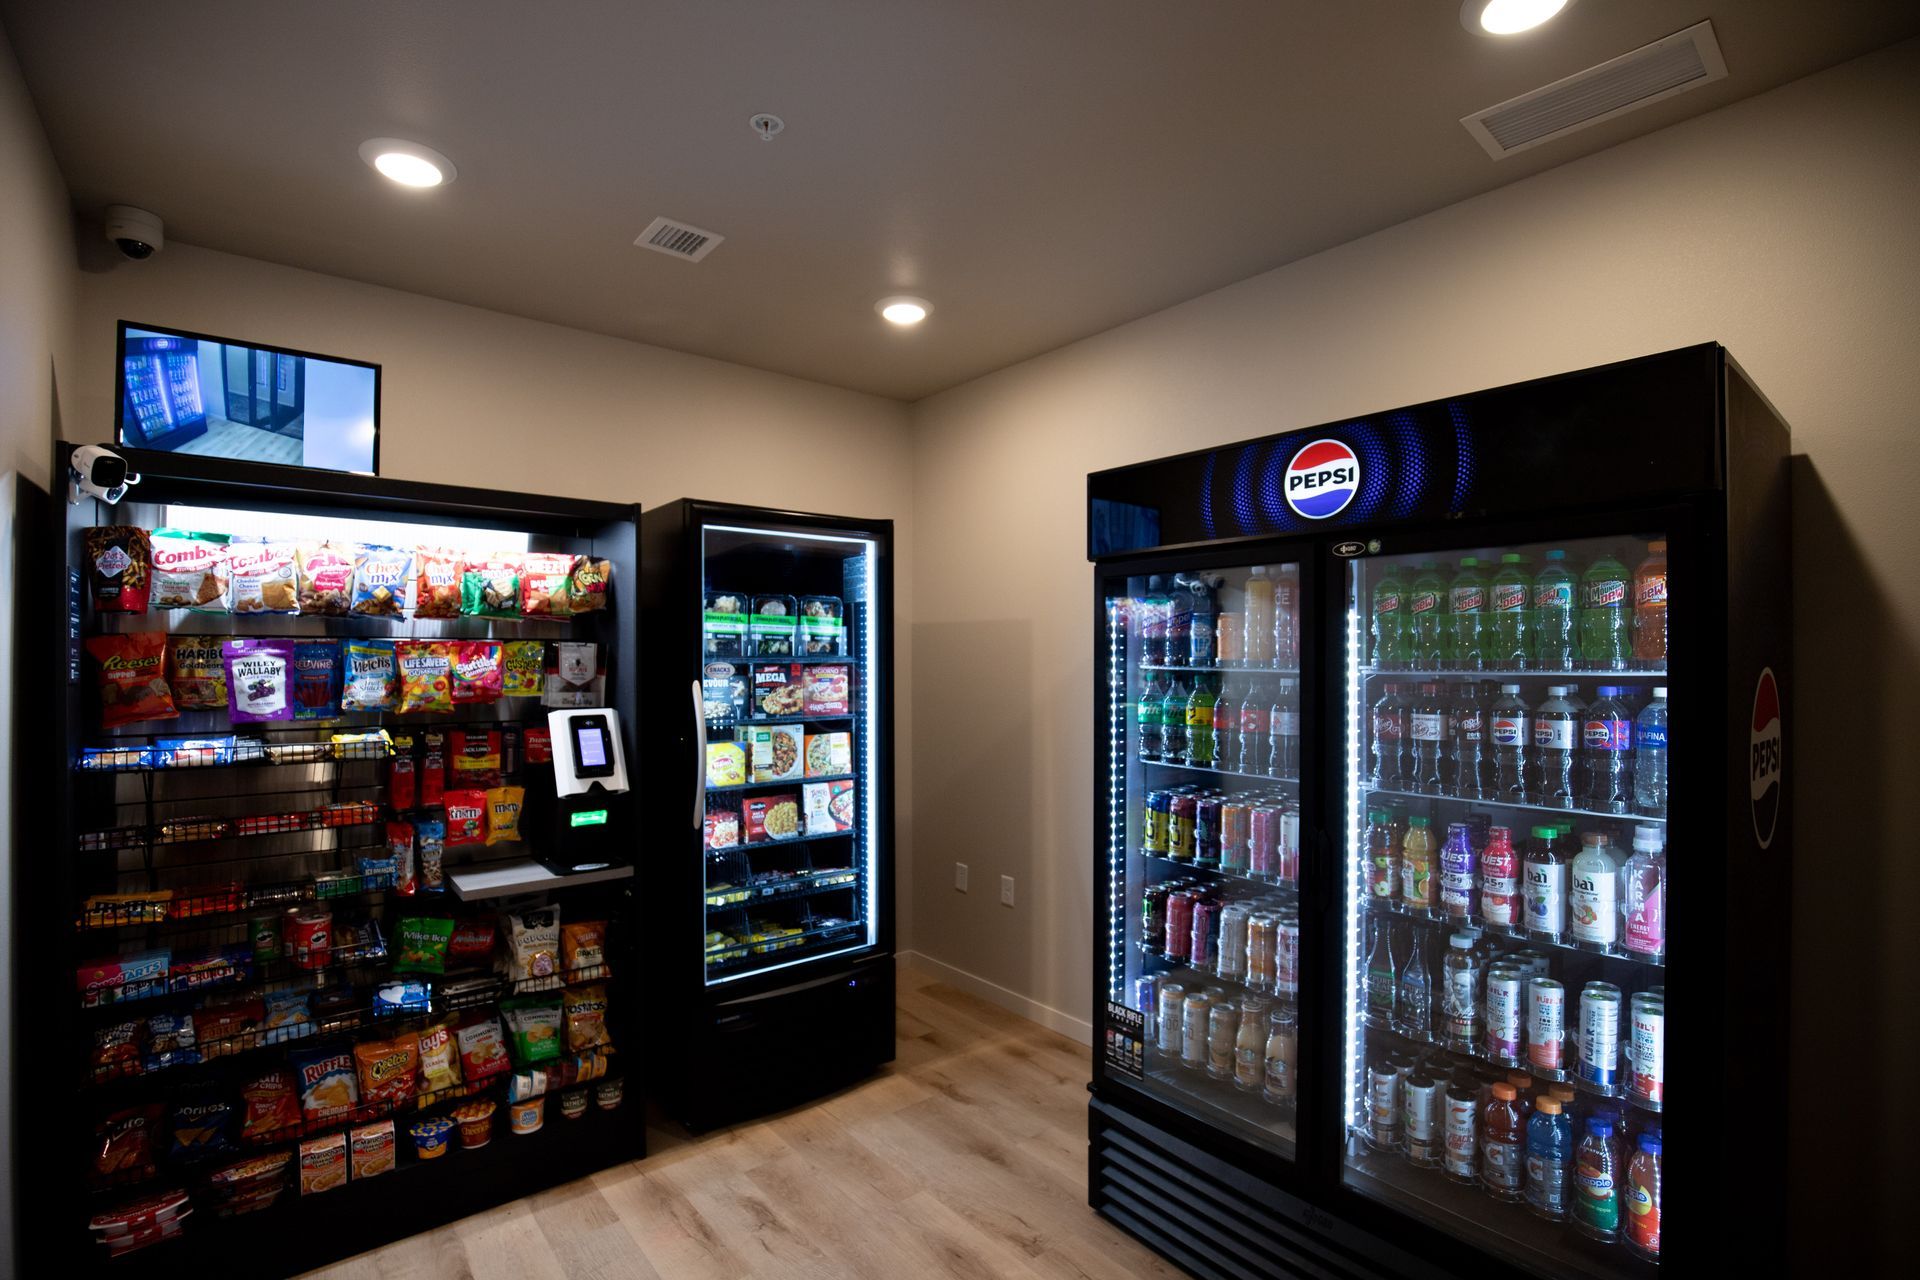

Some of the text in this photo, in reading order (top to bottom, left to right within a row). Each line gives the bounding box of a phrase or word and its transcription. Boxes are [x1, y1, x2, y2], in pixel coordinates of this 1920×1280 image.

[1290, 467, 1354, 491] PEPSI
[366, 562, 400, 576] Chex
[370, 573, 399, 586] mix
[431, 573, 455, 586] mix
[103, 655, 160, 670] Reese's
[353, 658, 391, 673] Welch's
[456, 656, 498, 674] Skittles
[506, 655, 542, 672] Gushers
[238, 667, 281, 677] WALLABY
[755, 673, 787, 684] MEGA
[1752, 737, 1780, 781] PEPSI
[1527, 868, 1548, 884] bai
[1574, 874, 1594, 892] bai
[1633, 869, 1645, 923] KARMA
[403, 931, 430, 940] Mike
[432, 934, 448, 942] Ike
[188, 967, 236, 985] CRUNCH
[1108, 1002, 1126, 1017] BLACK
[303, 1055, 352, 1084] RUFFLE
[371, 1052, 409, 1079] Cheetos
